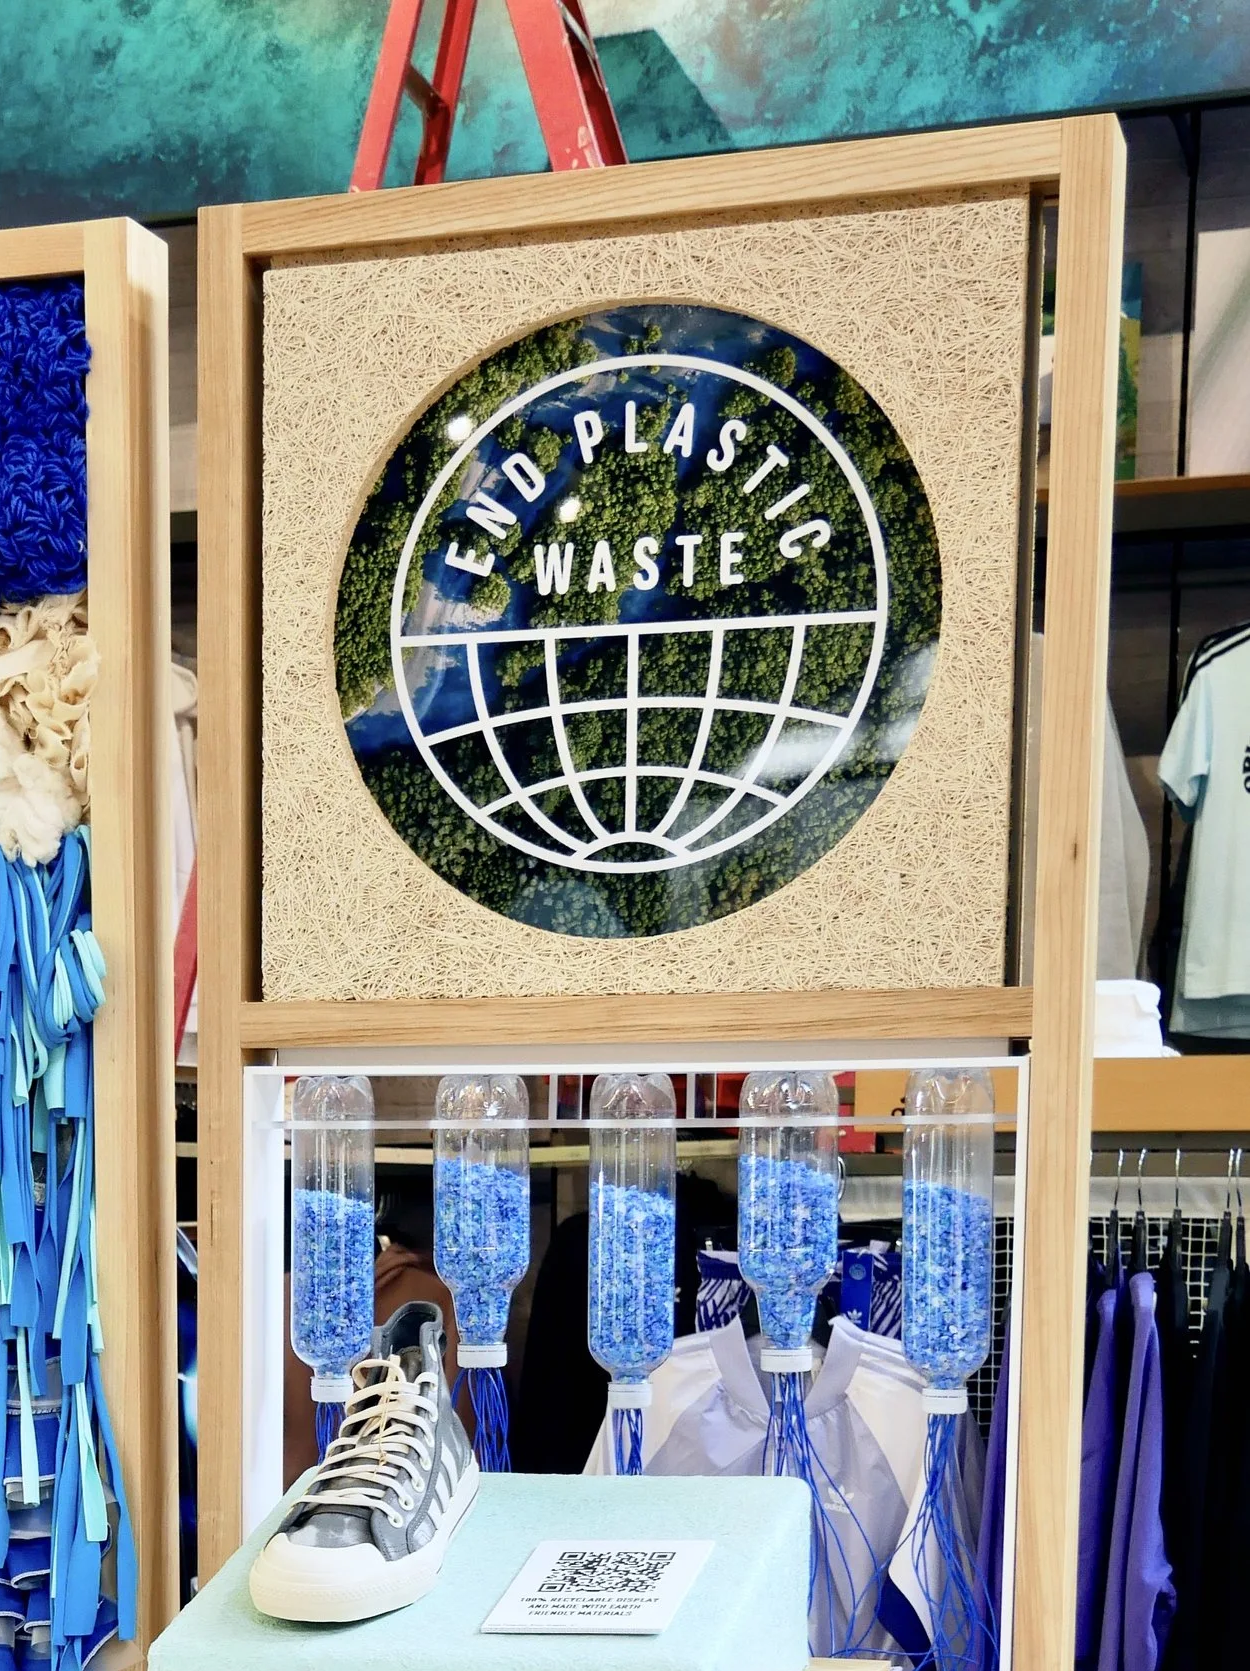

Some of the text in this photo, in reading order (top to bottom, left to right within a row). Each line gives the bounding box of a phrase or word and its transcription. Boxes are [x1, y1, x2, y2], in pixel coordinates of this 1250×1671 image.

[445, 400, 831, 577] END PLASTIC
[534, 532, 745, 596] WASTE
